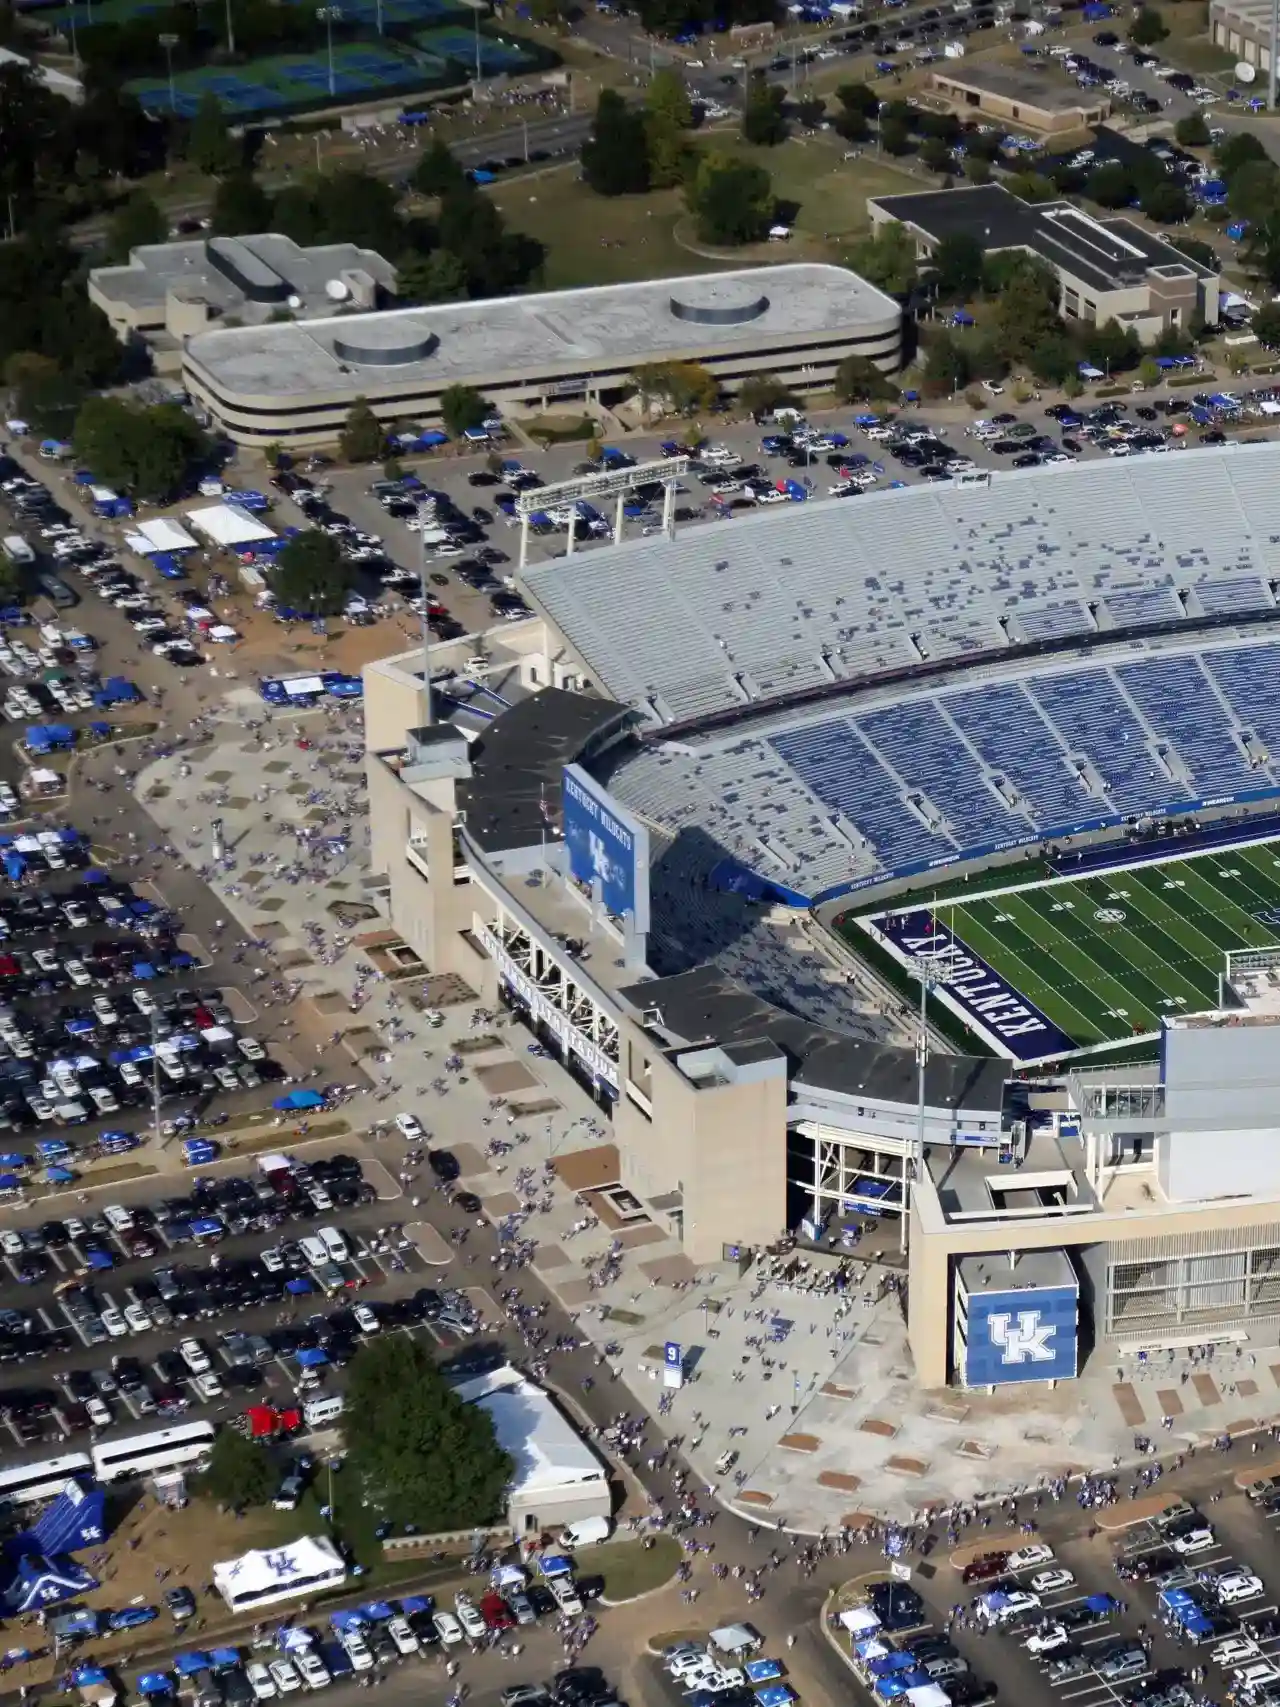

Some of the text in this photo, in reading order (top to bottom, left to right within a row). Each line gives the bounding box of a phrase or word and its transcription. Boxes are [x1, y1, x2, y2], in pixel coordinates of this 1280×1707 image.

[565, 776, 599, 821] KENTUCKY
[600, 807, 632, 851] WILDCATS
[851, 877, 873, 890] KENTUCKY
[1162, 996, 1188, 1007] 20
[1108, 1008, 1129, 1018] 10
[987, 1310, 1056, 1364] UK
[667, 1347, 677, 1361] 9
[262, 1551, 302, 1577] UK
